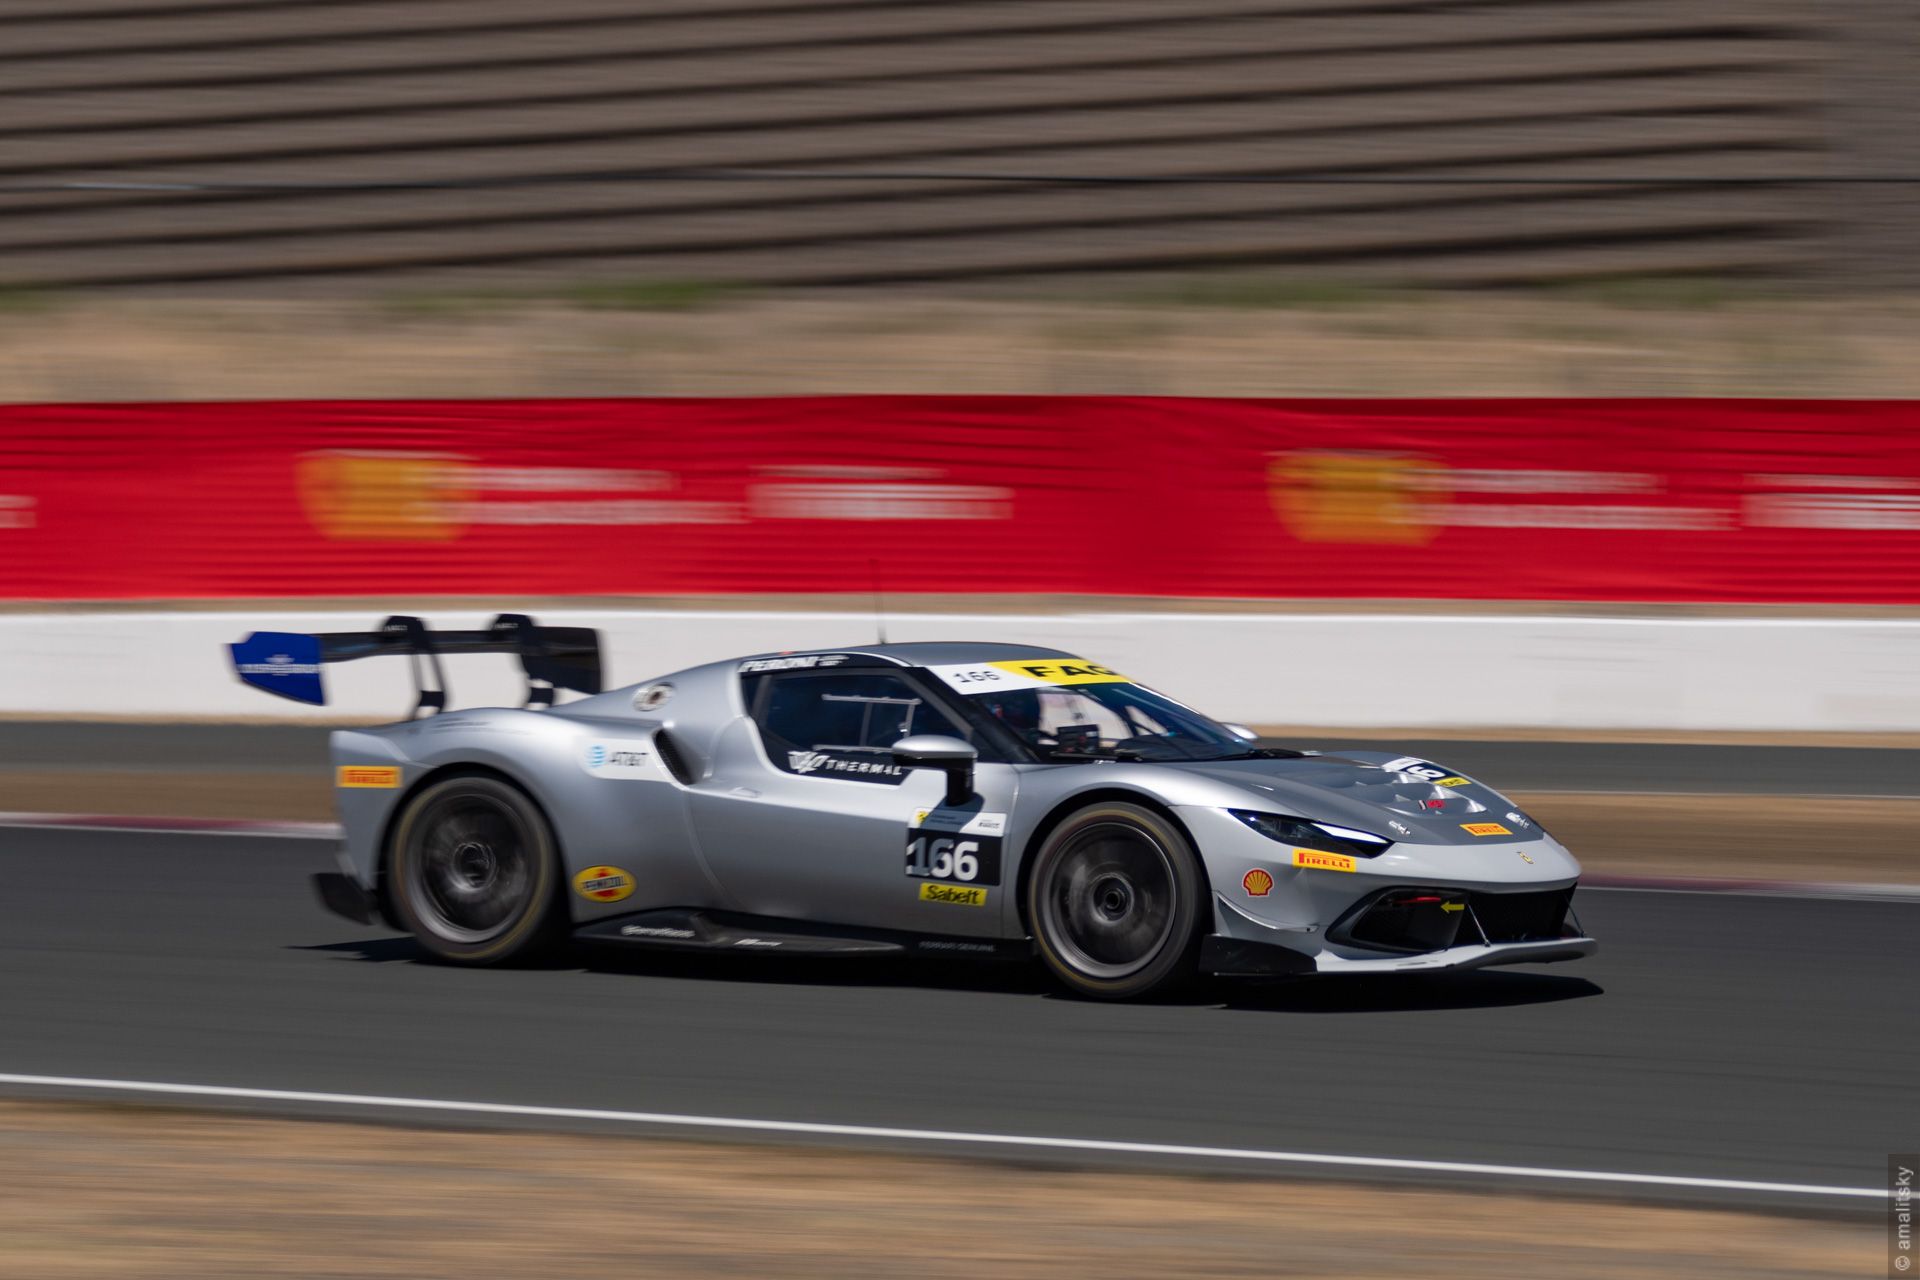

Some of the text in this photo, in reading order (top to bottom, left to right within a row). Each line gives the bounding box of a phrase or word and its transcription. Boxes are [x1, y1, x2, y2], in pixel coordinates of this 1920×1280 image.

[953, 671, 1001, 683] 166
[825, 759, 902, 775] THERMAL
[905, 837, 979, 881] 166
[1299, 852, 1350, 869] PIRELLI
[926, 885, 980, 904] Sabelt
